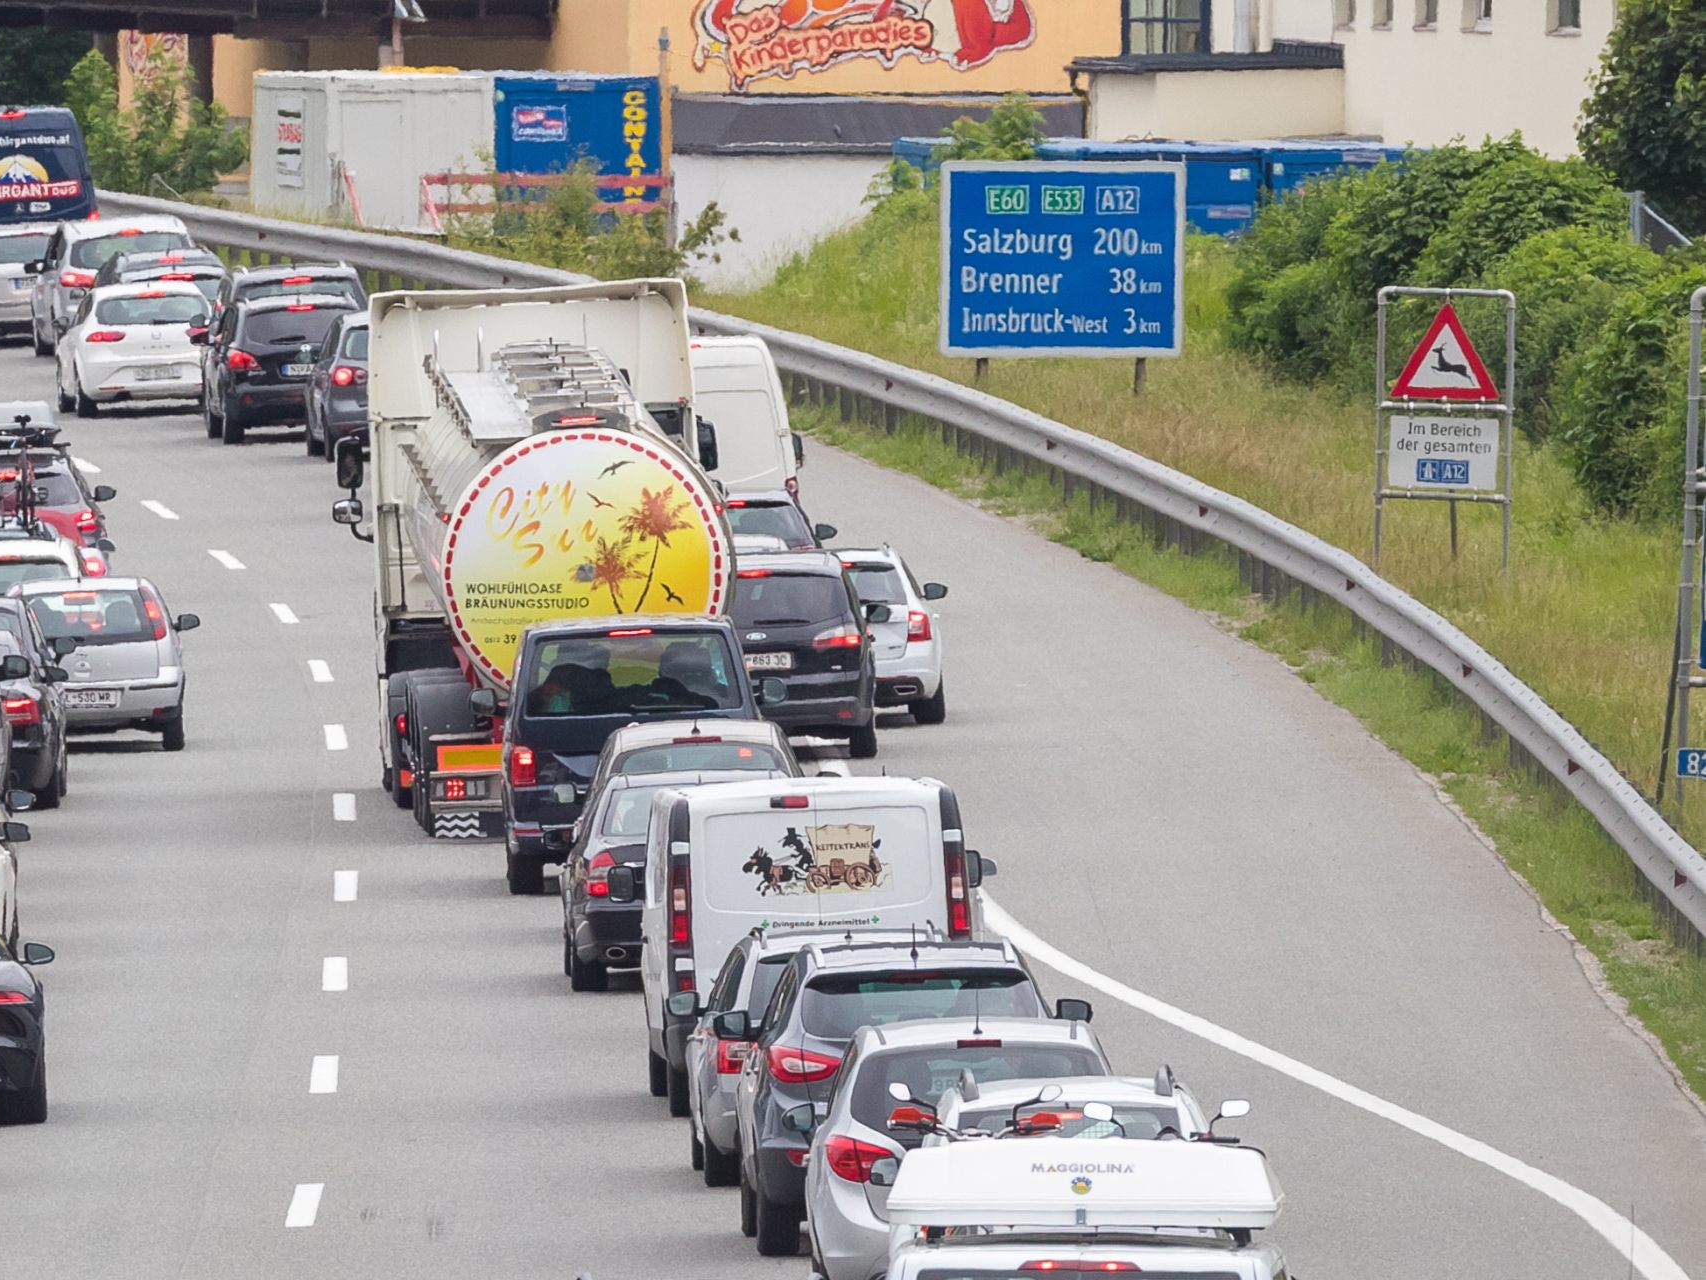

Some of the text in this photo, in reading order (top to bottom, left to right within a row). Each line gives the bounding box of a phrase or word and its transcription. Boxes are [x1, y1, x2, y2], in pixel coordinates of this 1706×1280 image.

[729, 13, 774, 44] Das
[733, 20, 927, 70] Kinderparadies
[988, 190, 1136, 211] E60 E533 A12
[963, 228, 1163, 260] Salzburg 200 km
[961, 266, 1162, 294] Brenner 38 km
[962, 307, 1161, 334] Innsbruck-West 3 km
[1408, 422, 1482, 437] Im Bereich
[1396, 438, 1492, 454] der gesamten
[1443, 464, 1465, 479] A12
[465, 581, 563, 595] WOHLFÜHLOASE
[465, 596, 590, 609] BRÄUNUNGSSTUDIO
[772, 918, 870, 929] Dringende Arzneimittel
[1030, 1162, 1134, 1174] MAGGIOLINA
